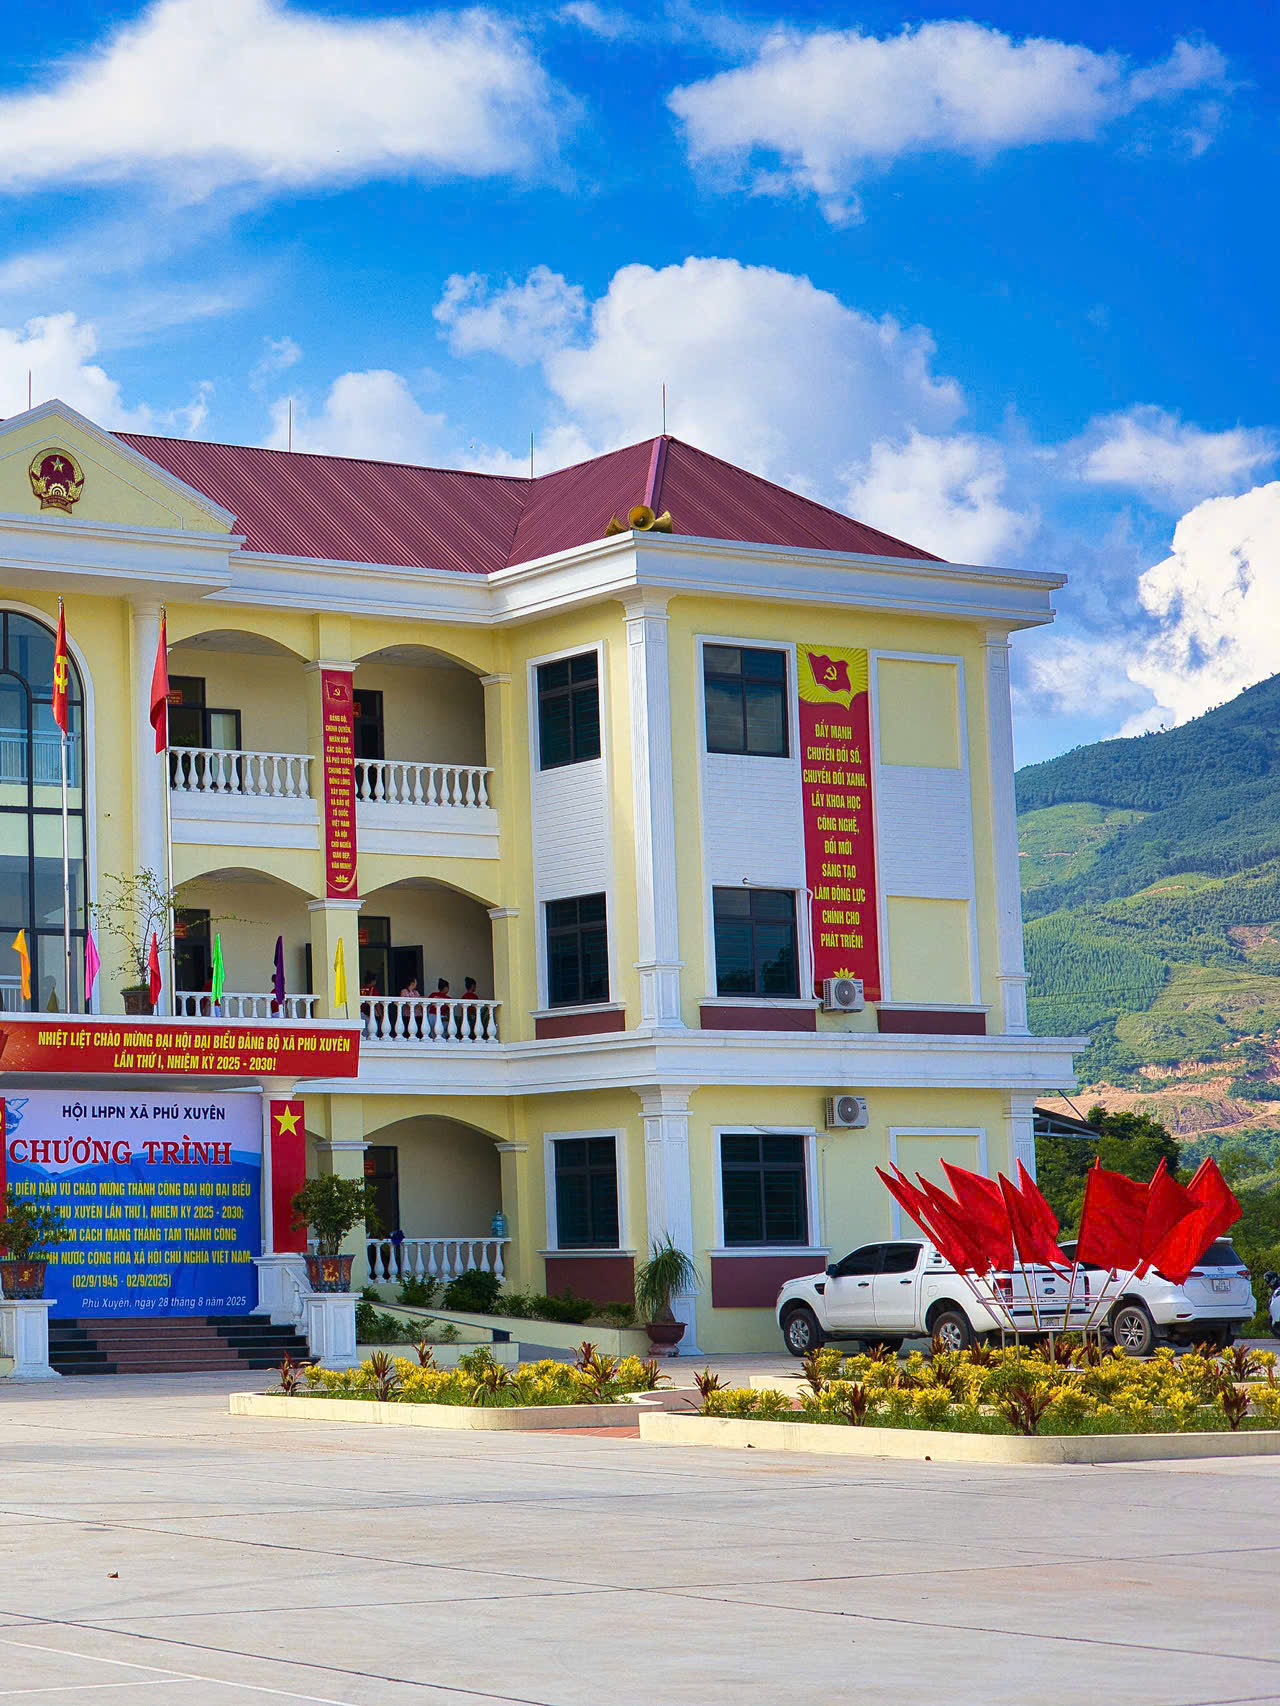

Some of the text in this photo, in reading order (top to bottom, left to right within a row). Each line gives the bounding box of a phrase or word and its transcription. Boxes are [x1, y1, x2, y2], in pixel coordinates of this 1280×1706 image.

[831, 725, 852, 742] MẠNH
[807, 742, 834, 761] CHUYỂN
[836, 744, 848, 762] ĐỔI
[803, 766, 867, 788] CHUYỂN ĐỔI XANH,
[812, 789, 861, 812] LẤY KHOA HỌC
[817, 814, 837, 831] CÔNG
[825, 836, 852, 855] ĐỔI MỚI
[822, 861, 857, 881] SÁNG TẠO
[814, 884, 866, 905] LÀM ĐỘNG LỰC
[822, 908, 860, 925] CHÍNH CHO
[821, 930, 838, 947] PHÁT
[38, 1029, 350, 1053] NHIỆT LIỆT CHÀO MỪNG ĐẠI HỘI ĐẠI BIỂU ĐẢNG BỘ XÃ PHÚ XUYÊN
[114, 1050, 134, 1068] LẦN
[136, 1052, 156, 1068] THỨ
[158, 1055, 164, 1070] I,
[167, 1052, 199, 1072] NHIỆM
[202, 1053, 215, 1070] KỲ
[217, 1056, 240, 1070] 2025
[249, 1057, 276, 1071] 2030!
[62, 1102, 225, 1121] HỘI LHPN XÃ PHÚ XUYÊN
[9, 1134, 232, 1164] CHƯƠNG TRÌNH
[74, 1179, 97, 1196] CHÀO
[99, 1180, 125, 1196] MỪNG
[128, 1180, 155, 1196] THÀNH
[158, 1180, 181, 1196] CÔNG
[183, 1182, 197, 1198] ĐẠI
[200, 1180, 213, 1198] HỘI
[216, 1183, 230, 1198] ĐẠI
[232, 1178, 251, 1196] BIỂU
[194, 1206, 214, 1218] 2025
[80, 1226, 102, 1241] CÁCH
[106, 1229, 130, 1244] MẠNG
[184, 1226, 212, 1241] THÀNH
[214, 1226, 237, 1241] CÔNG
[88, 1248, 111, 1267] CỘNG
[134, 1248, 145, 1264] XÃ
[148, 1248, 162, 1267] HỘI
[165, 1247, 181, 1264] CHỦ
[212, 1248, 229, 1266] VIỆT
[232, 1250, 250, 1264] NAM
[72, 1275, 118, 1288] (02/9/1945
[126, 1274, 171, 1288] 02/9/2025)
[82, 1298, 100, 1308] Phú
[135, 1298, 156, 1310] ngày
[158, 1297, 168, 1307] 28
[171, 1296, 196, 1309] tháng
[198, 1297, 203, 1306] 8
[206, 1297, 224, 1306] năm
[226, 1296, 246, 1306] 2025
